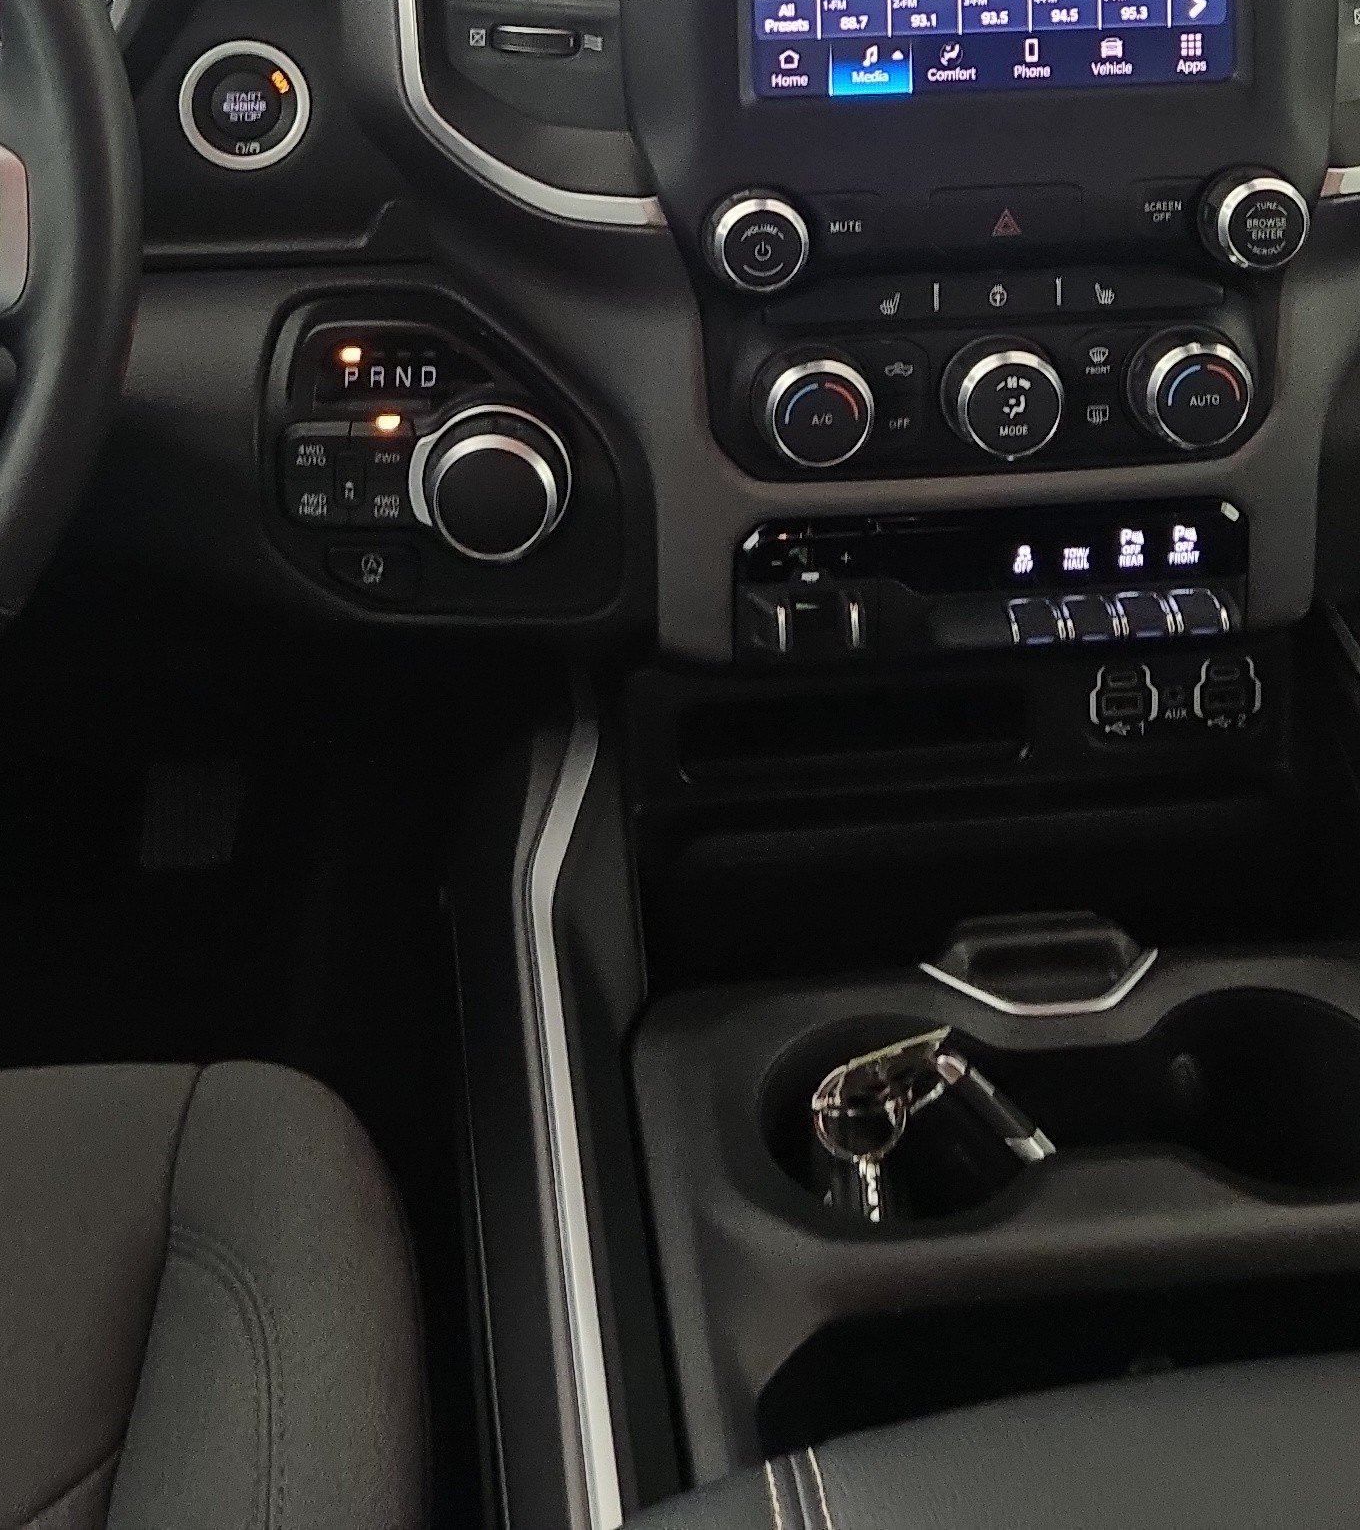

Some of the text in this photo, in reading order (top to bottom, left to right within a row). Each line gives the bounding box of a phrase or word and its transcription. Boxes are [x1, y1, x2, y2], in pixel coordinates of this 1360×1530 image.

[778, 3, 796, 18] All
[980, 10, 1009, 25] 93.5
[1051, 8, 1078, 23] 94.5
[1120, 6, 1148, 21] 95.3
[764, 19, 810, 33] Presets
[910, 13, 937, 28] 93.1
[1013, 65, 1051, 79] Phone
[1092, 62, 1133, 76] Vehicle
[1177, 58, 1207, 74] Apps
[771, 74, 809, 88] Home
[852, 69, 889, 84] Media
[927, 66, 977, 82] Comfort
[1144, 200, 1182, 212] SCREEN
[1153, 212, 1172, 223] OFF
[1246, 217, 1287, 229] BROWSE
[829, 220, 862, 234] MUTE
[1252, 229, 1283, 240] ENTER
[345, 366, 437, 388] P R N D
[1189, 395, 1220, 407] AUTO
[811, 413, 833, 426] A/C
[889, 417, 910, 429] OFF
[1000, 425, 1029, 436] MODE
[298, 444, 325, 455] 4WD
[296, 455, 327, 467] AUTO
[1122, 544, 1142, 554] OFF
[1174, 541, 1194, 551] OFF
[1168, 550, 1200, 565] FRONT
[1013, 558, 1033, 573] OFF
[1164, 708, 1188, 720] AUX
